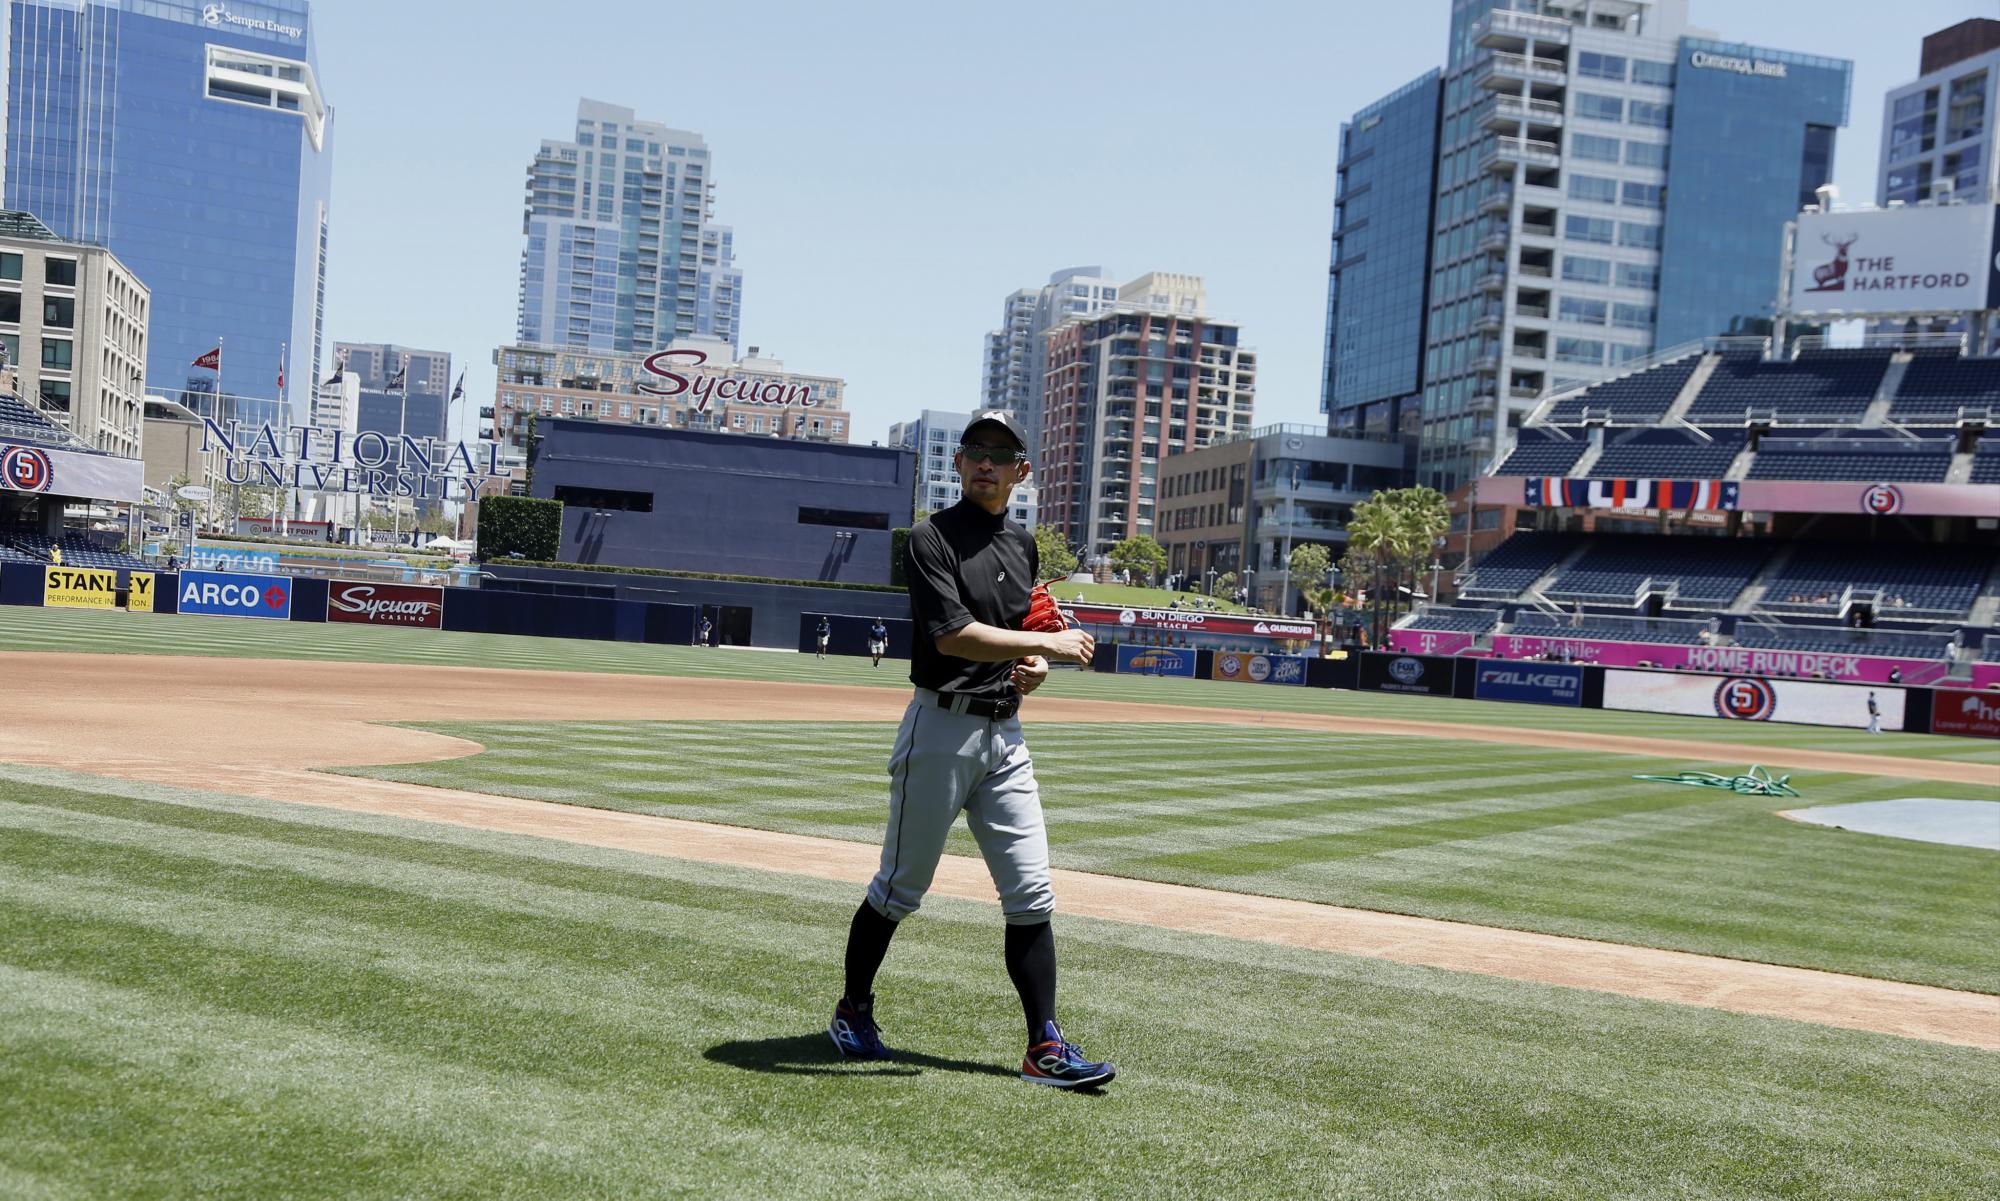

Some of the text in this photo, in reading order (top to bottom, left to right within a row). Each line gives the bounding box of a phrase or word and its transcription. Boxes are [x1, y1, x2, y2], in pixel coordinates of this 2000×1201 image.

[224, 11, 303, 39] Sempra Energy
[1754, 58, 1787, 78] Bank
[1855, 256, 1894, 272] THE
[1853, 272, 1970, 291] HARTFORD
[637, 349, 817, 413] Sycuan
[199, 416, 512, 478] NATIONAL
[224, 456, 488, 502] UNIVERSITY
[262, 525, 319, 536] BALST POINT
[47, 594, 102, 605] PERFORMANCE
[181, 582, 260, 608] ARCO
[341, 586, 431, 620] Sycuan
[380, 613, 425, 622] CASINO
[1141, 611, 1205, 624] SUN DIEGO
[1156, 621, 1188, 630] BEACH
[1270, 624, 1313, 635] QUIKSILVER
[1397, 662, 1415, 673] FOX
[1687, 648, 1861, 676] HOME RUN DECK
[1481, 670, 1579, 689] FALKEN
[1552, 689, 1575, 698] TIRES
